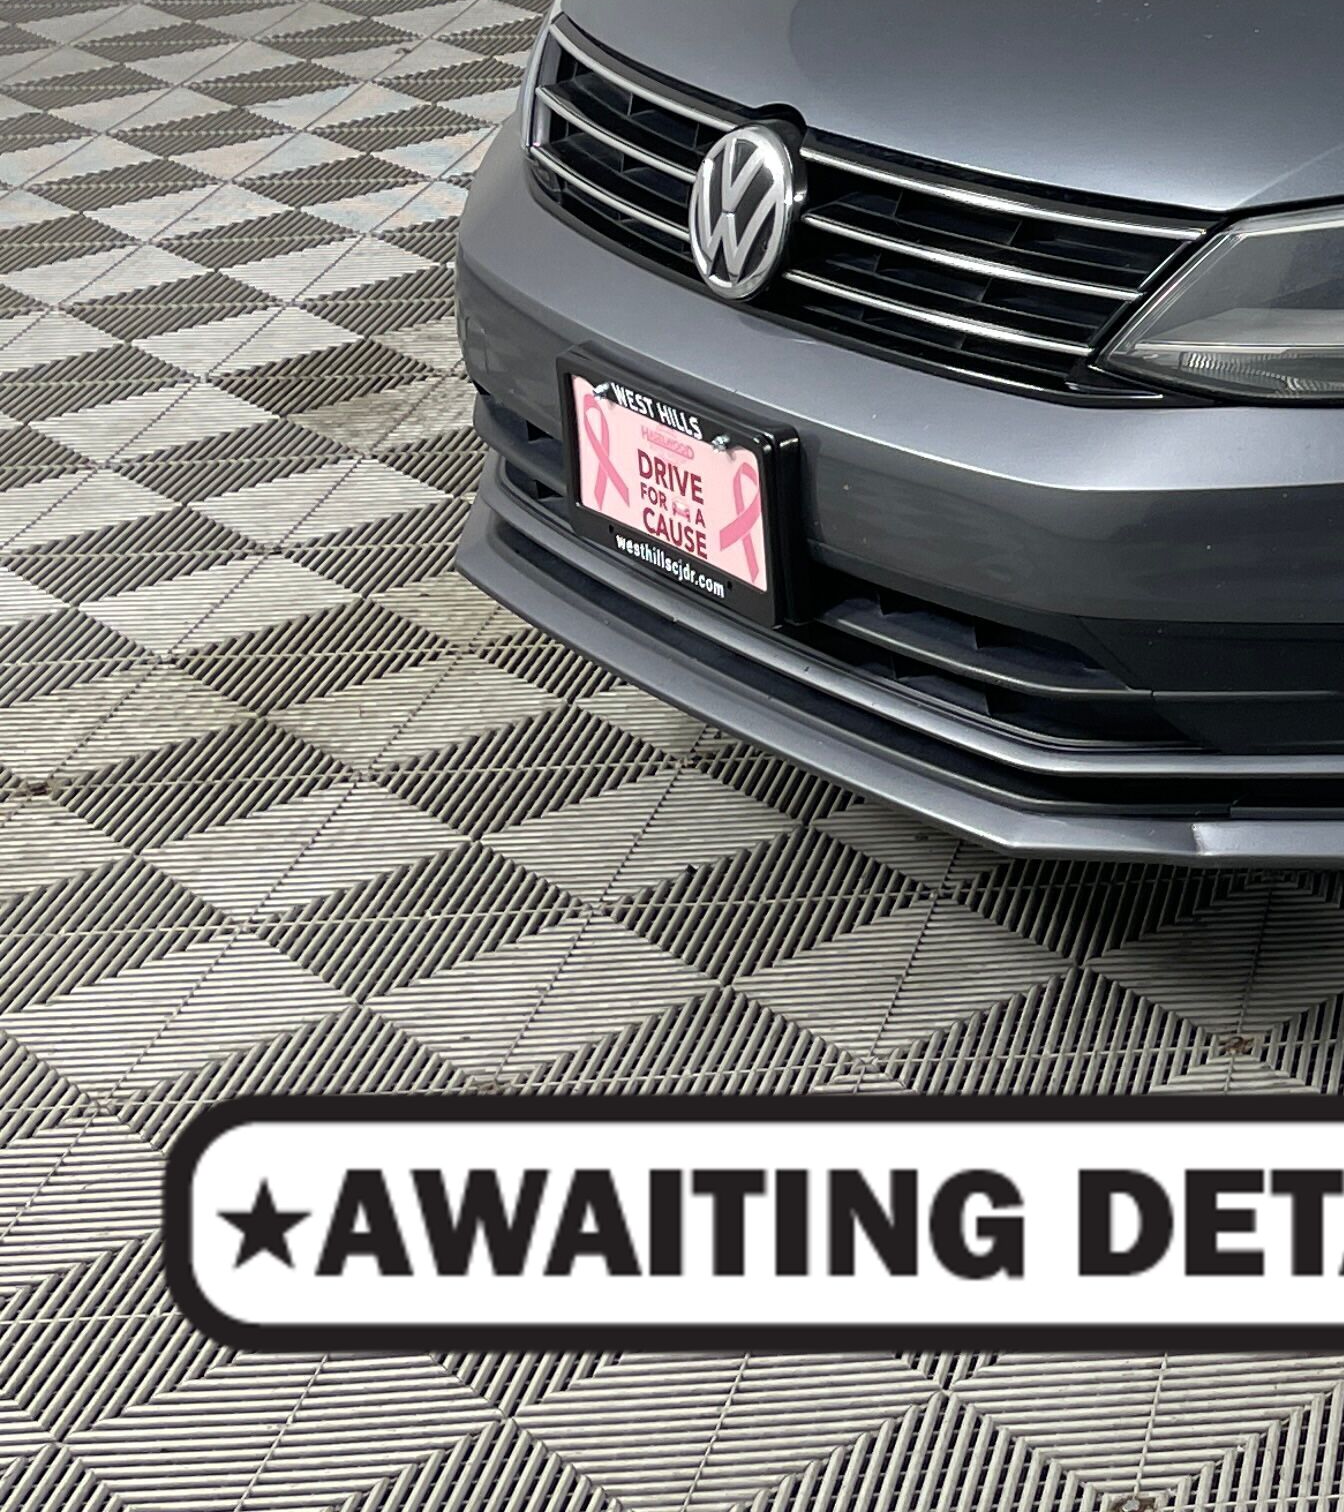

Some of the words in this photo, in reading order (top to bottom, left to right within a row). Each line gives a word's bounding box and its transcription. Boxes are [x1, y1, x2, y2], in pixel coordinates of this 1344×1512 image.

[611, 382, 655, 419] WEST
[656, 403, 703, 439] HILLS
[637, 449, 704, 505] DRIVE
[640, 482, 668, 510] FOR
[695, 508, 706, 529] A
[642, 507, 708, 560] CAUSE
[616, 534, 726, 598] westhillscjdr.com
